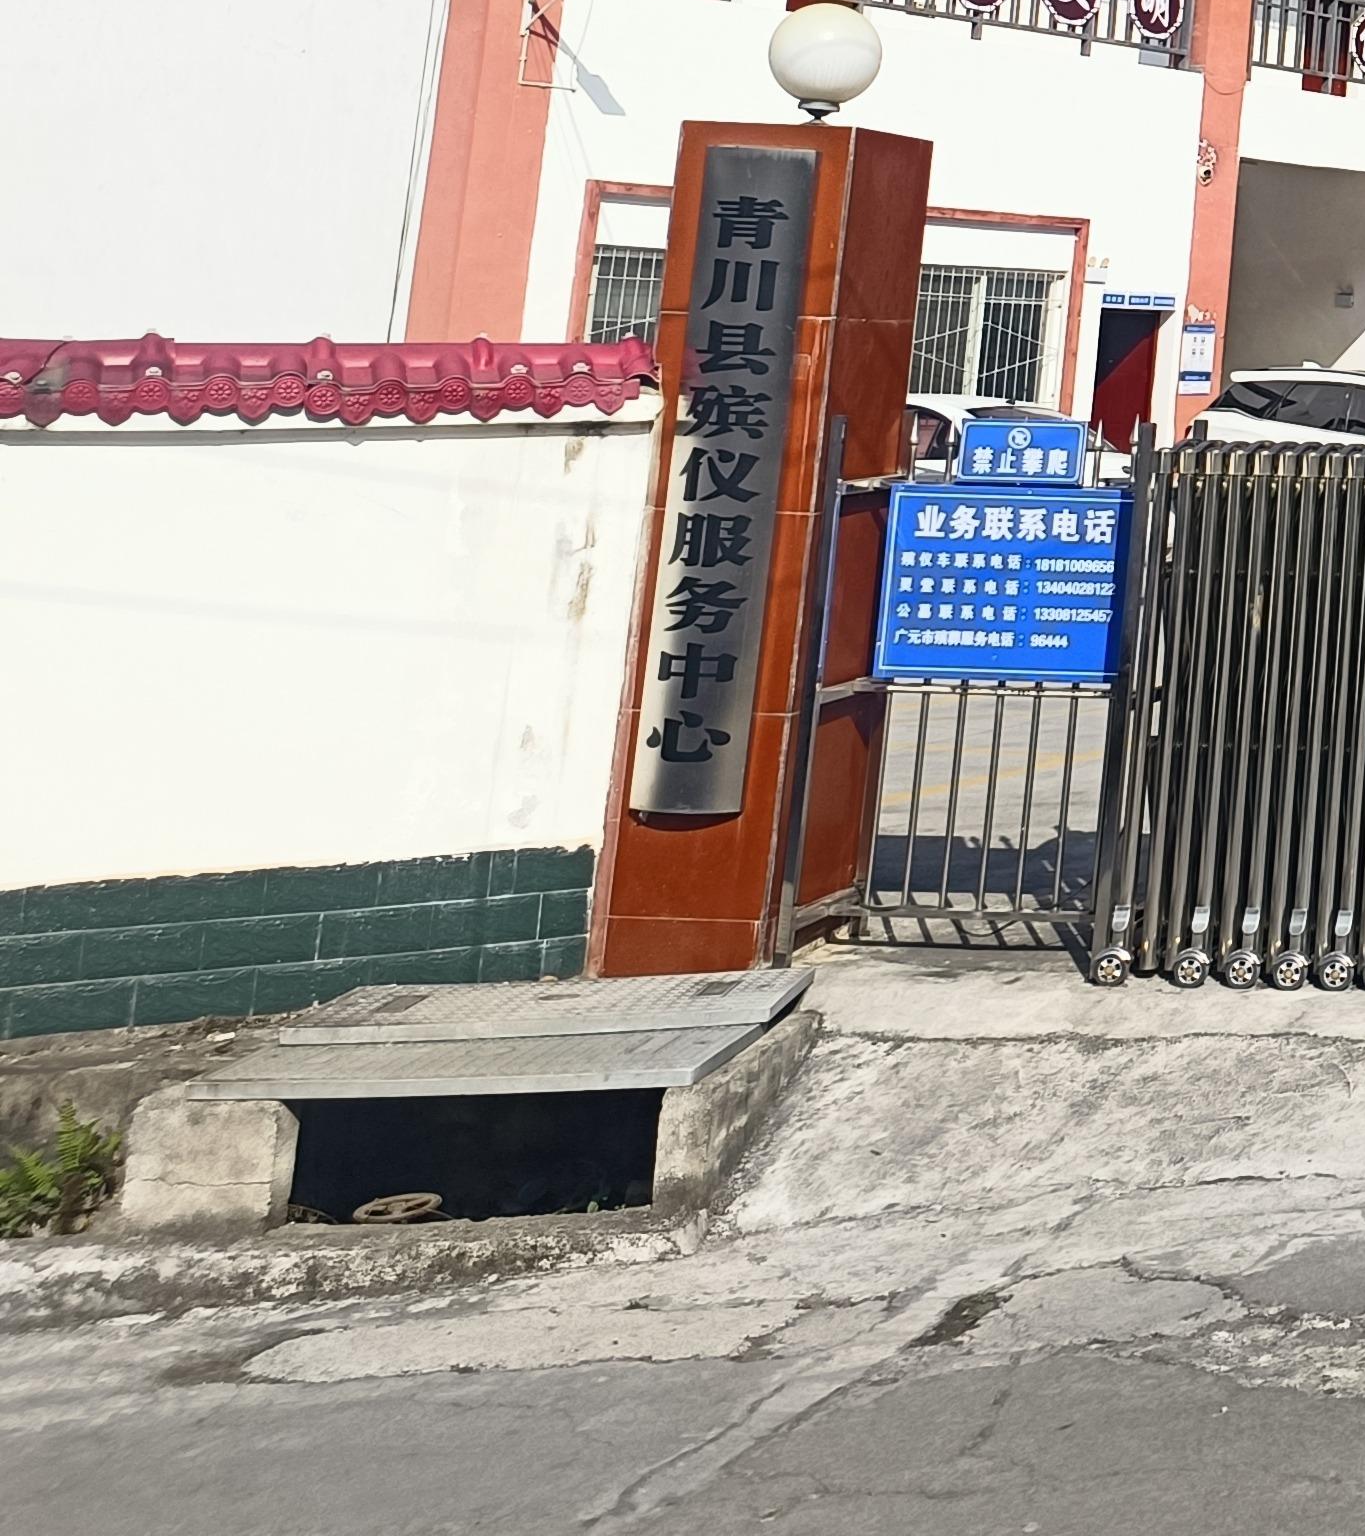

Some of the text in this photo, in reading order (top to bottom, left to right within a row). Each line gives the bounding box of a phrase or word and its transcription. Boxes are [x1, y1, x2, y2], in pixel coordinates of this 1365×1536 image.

[645, 194, 790, 763] 青川县殡仪服务中心
[971, 445, 1069, 476] 禁止攀爬
[914, 504, 1117, 544] 业务联系电话
